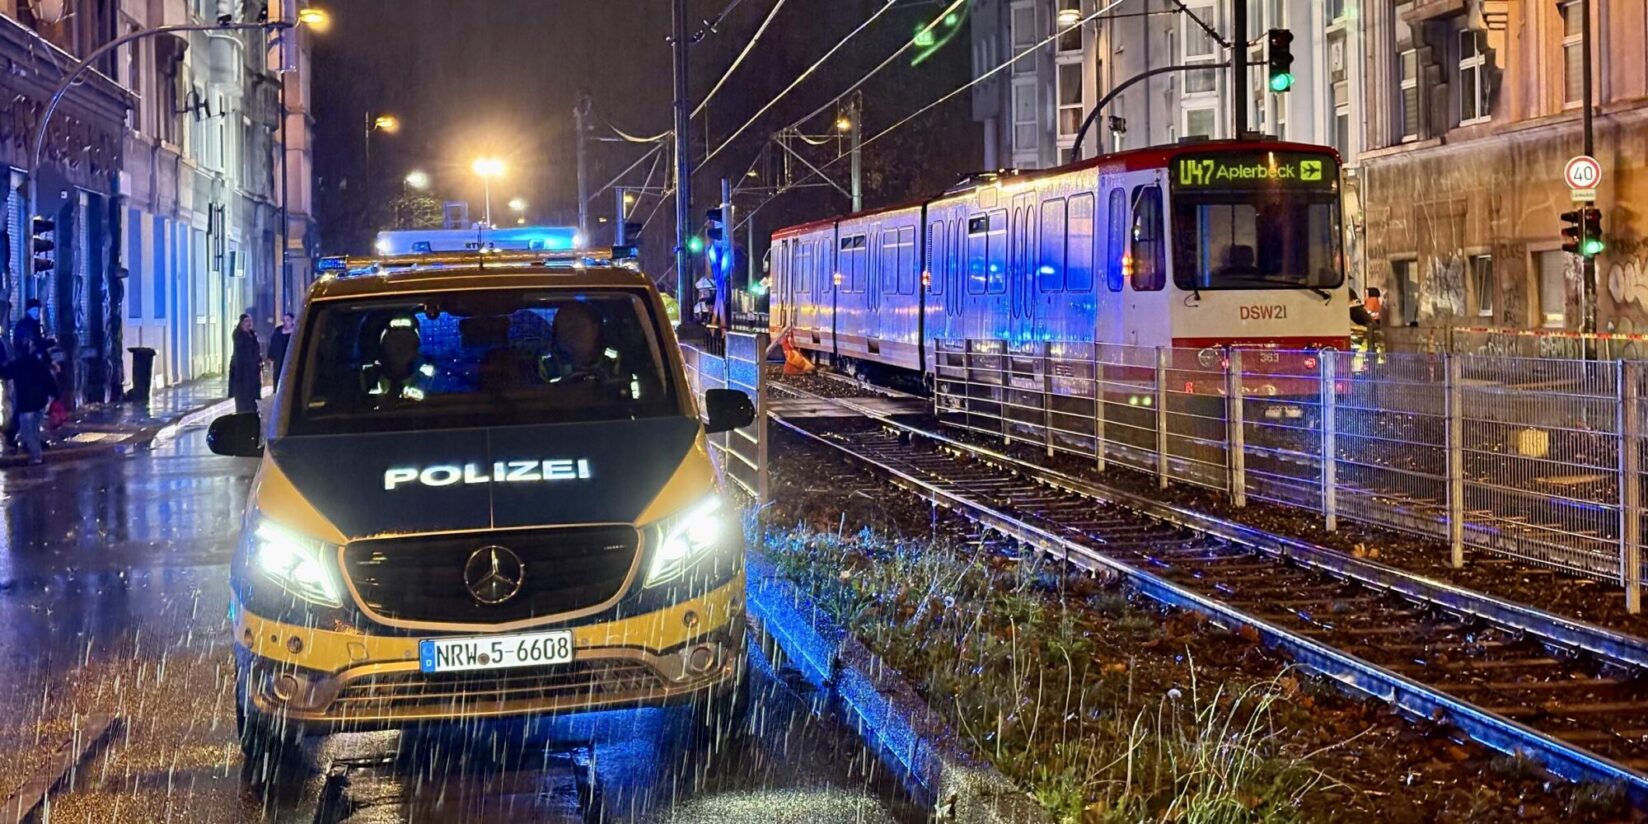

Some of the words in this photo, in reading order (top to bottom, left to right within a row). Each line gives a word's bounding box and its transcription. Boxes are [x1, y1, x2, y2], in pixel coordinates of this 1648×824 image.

[1180, 160, 1214, 185] U47
[1216, 164, 1295, 181] Aplerbeck
[1573, 166, 1593, 181] 40
[1260, 352, 1280, 363] 363
[384, 459, 591, 490] POLIZEI
[436, 643, 478, 667] NRW
[491, 637, 569, 664] 5-6608
